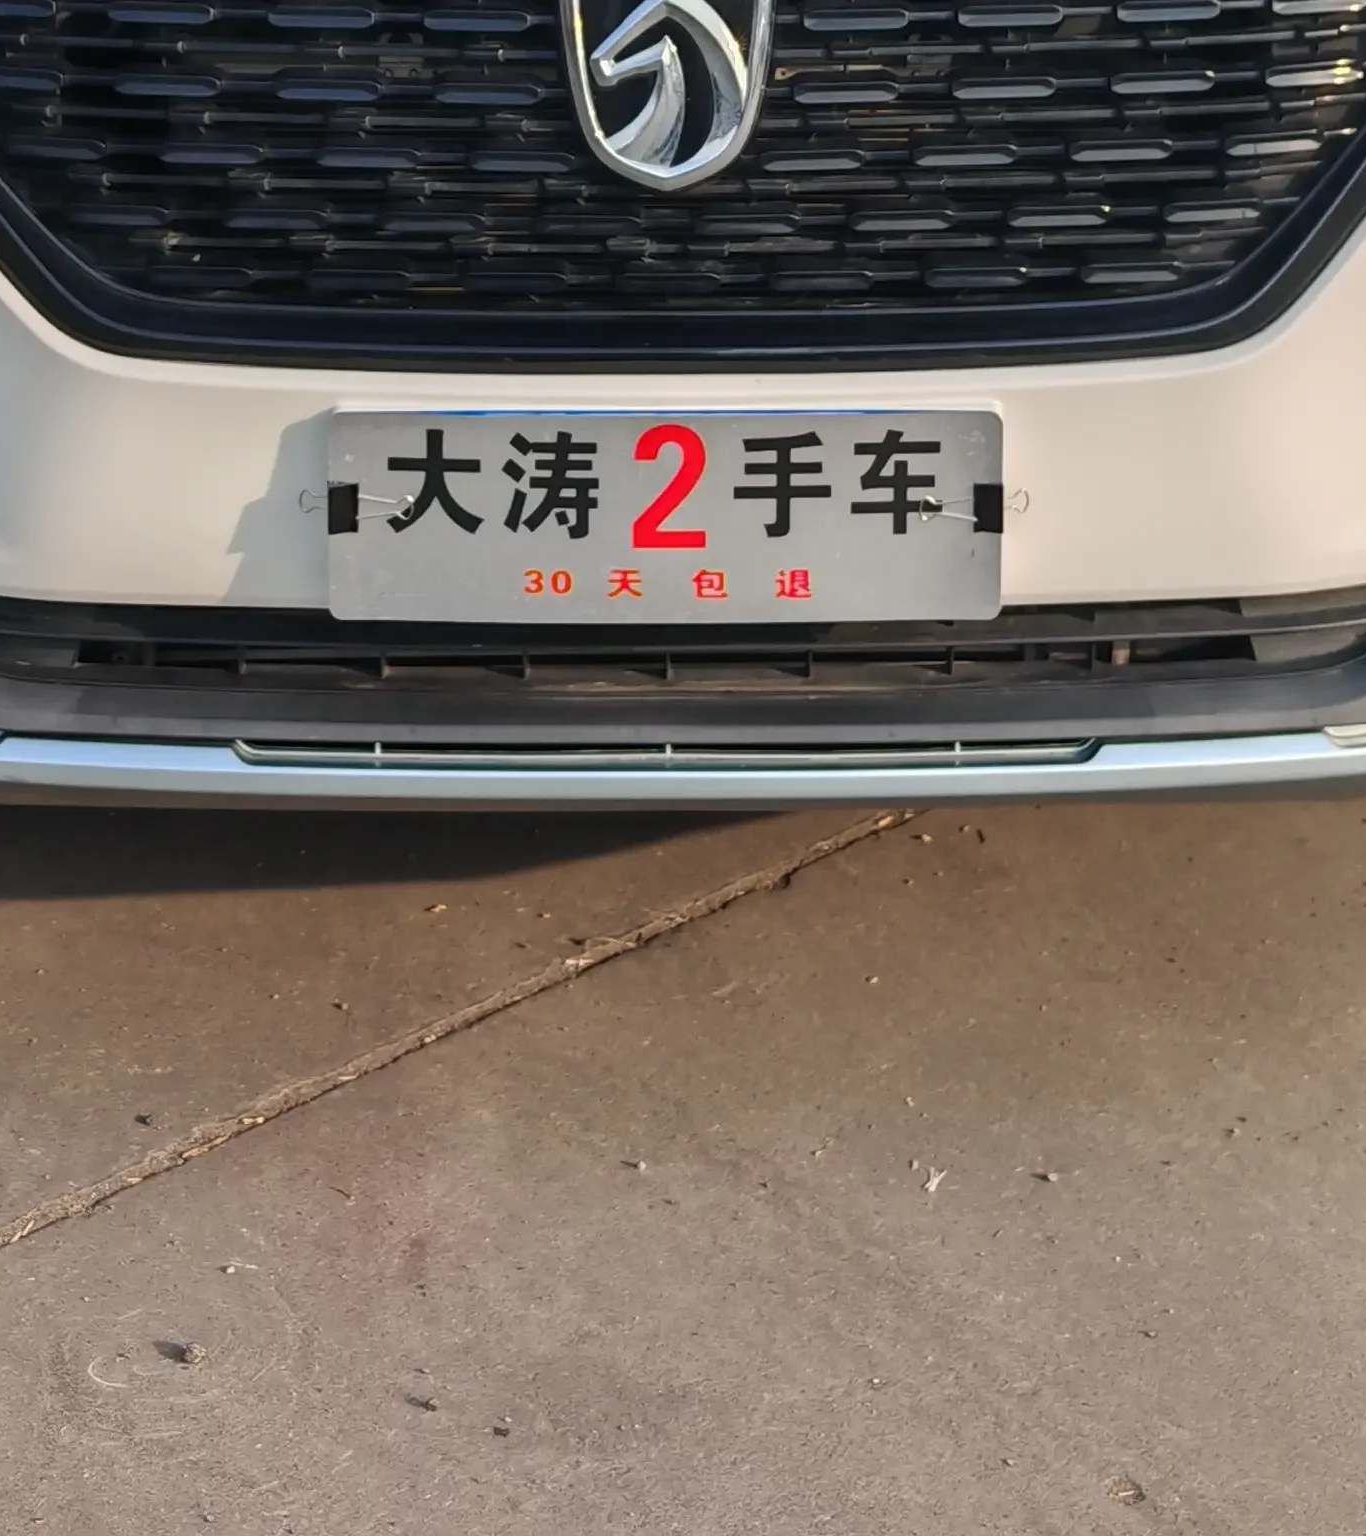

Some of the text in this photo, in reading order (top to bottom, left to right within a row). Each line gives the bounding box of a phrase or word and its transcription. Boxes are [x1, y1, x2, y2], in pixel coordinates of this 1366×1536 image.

[386, 423, 943, 549] 大涛2手车
[523, 568, 813, 600] 30天包退
